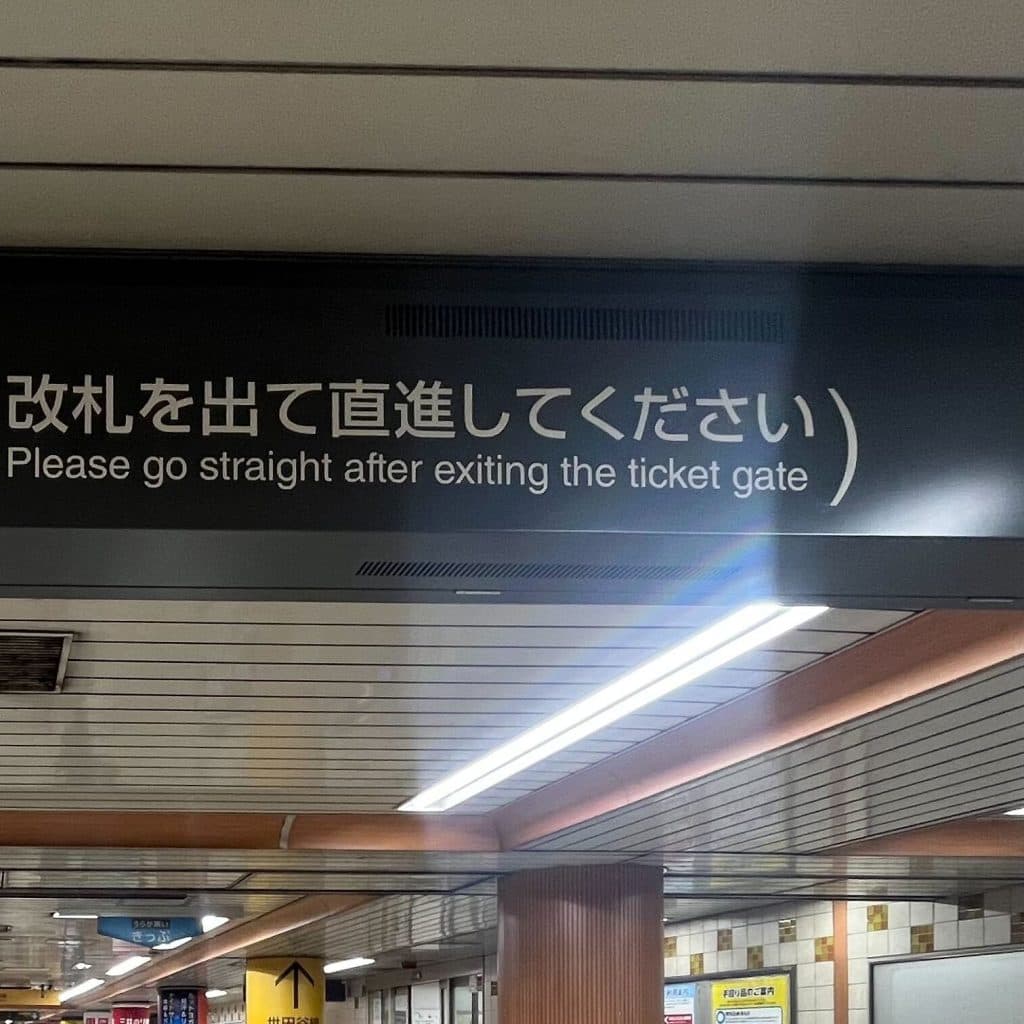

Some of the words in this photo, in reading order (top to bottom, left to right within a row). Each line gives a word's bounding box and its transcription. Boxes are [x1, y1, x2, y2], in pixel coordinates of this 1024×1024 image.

[7, 446, 130, 481] Please
[143, 456, 187, 488] go
[200, 451, 332, 490] straight
[344, 452, 423, 483] after
[434, 454, 549, 494] exiting
[560, 456, 616, 488] the
[628, 457, 721, 490] ticket
[732, 462, 809, 499] gate
